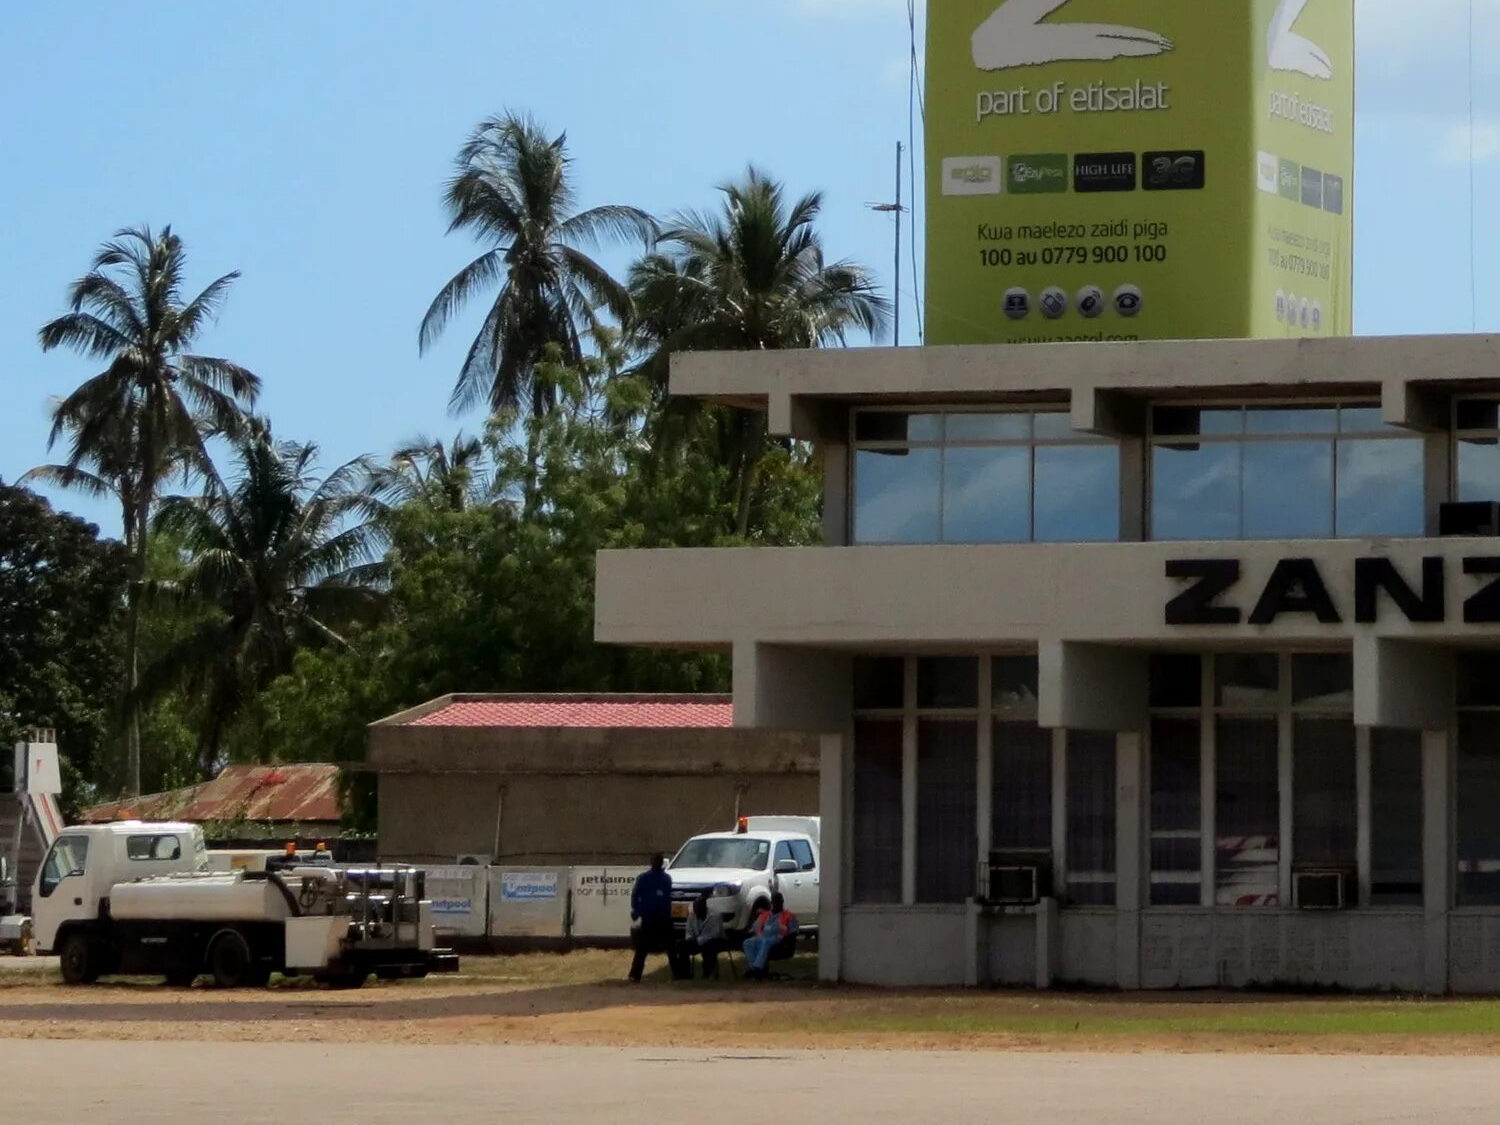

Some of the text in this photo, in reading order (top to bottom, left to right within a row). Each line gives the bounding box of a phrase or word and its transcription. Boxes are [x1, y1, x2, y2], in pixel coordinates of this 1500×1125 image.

[976, 79, 1169, 122] part of etisalat
[1075, 163, 1133, 176] HIGH LIFE
[1150, 156, 1196, 184] 3G
[978, 220, 1168, 240] Kwa maelezo zaidi piga
[980, 245, 1167, 266] 100 au 0779 900 100
[581, 876, 635, 886] jettaine
